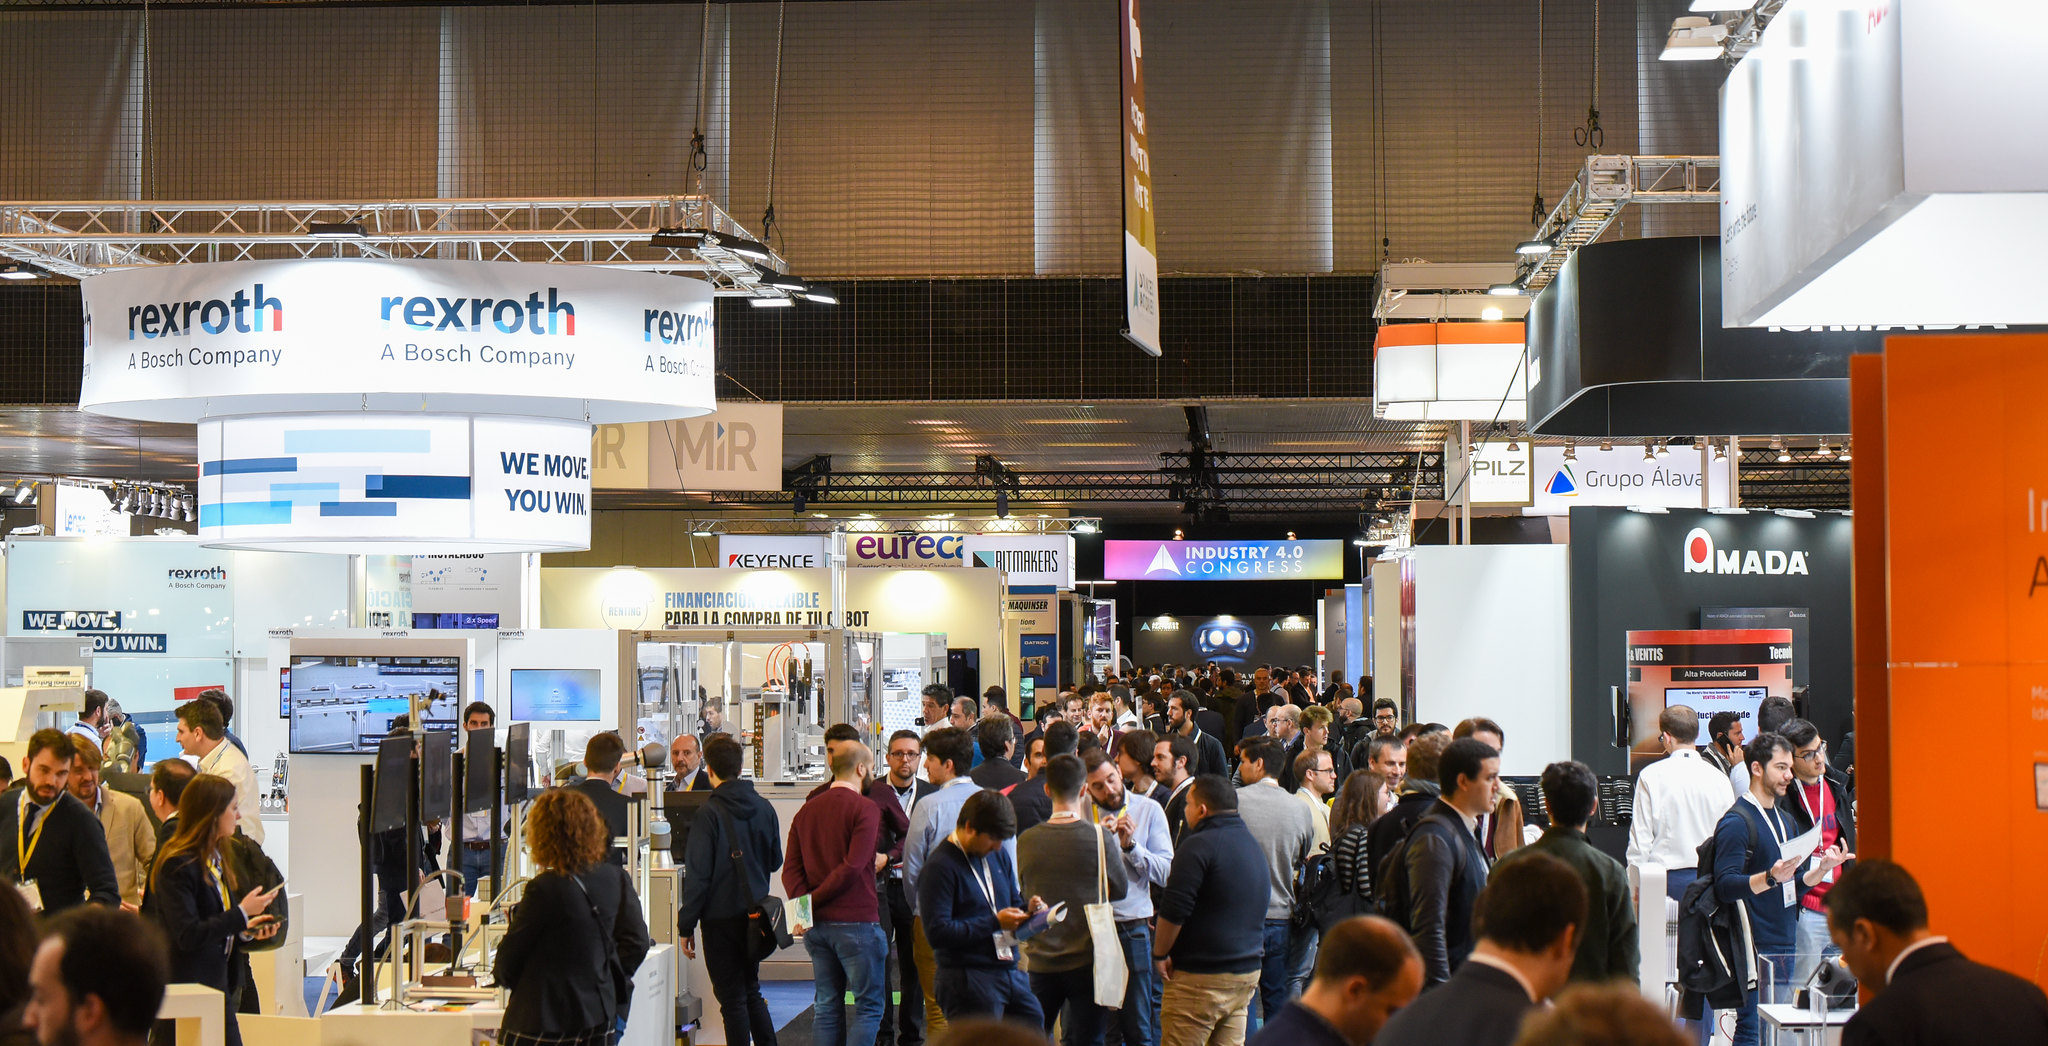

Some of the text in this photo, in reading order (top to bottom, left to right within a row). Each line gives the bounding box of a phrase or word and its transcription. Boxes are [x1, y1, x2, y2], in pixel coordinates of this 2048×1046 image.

[128, 283, 283, 341] rexroth
[380, 287, 576, 336] rexroth
[128, 346, 282, 370] A Bosch Company
[381, 343, 575, 370] A Bosch Company
[645, 355, 655, 373] A
[660, 355, 689, 376] Bosch
[500, 451, 589, 480] WE MOVE.
[1473, 460, 1526, 476] PILZ
[1585, 469, 1645, 491] Grupo
[505, 488, 587, 516] YOU WIN.
[1185, 546, 1303, 560] INDUSTRY 4.0
[1683, 527, 1809, 576] AMADA
[729, 554, 814, 568] KEYENCE
[1185, 560, 1303, 574] CONGRESS
[168, 565, 227, 580] rexroth
[196, 582, 226, 590] Company
[608, 607, 642, 617] RENTING
[1007, 600, 1049, 611] MAQUINSER
[27, 613, 117, 628] WE MOVE.
[665, 611, 869, 627] PARA LA COMPRA DE TU CBOT
[120, 636, 163, 651] WIN.
[1634, 647, 1664, 662] VENTIS
[1684, 669, 1747, 678] Alta Productividad
